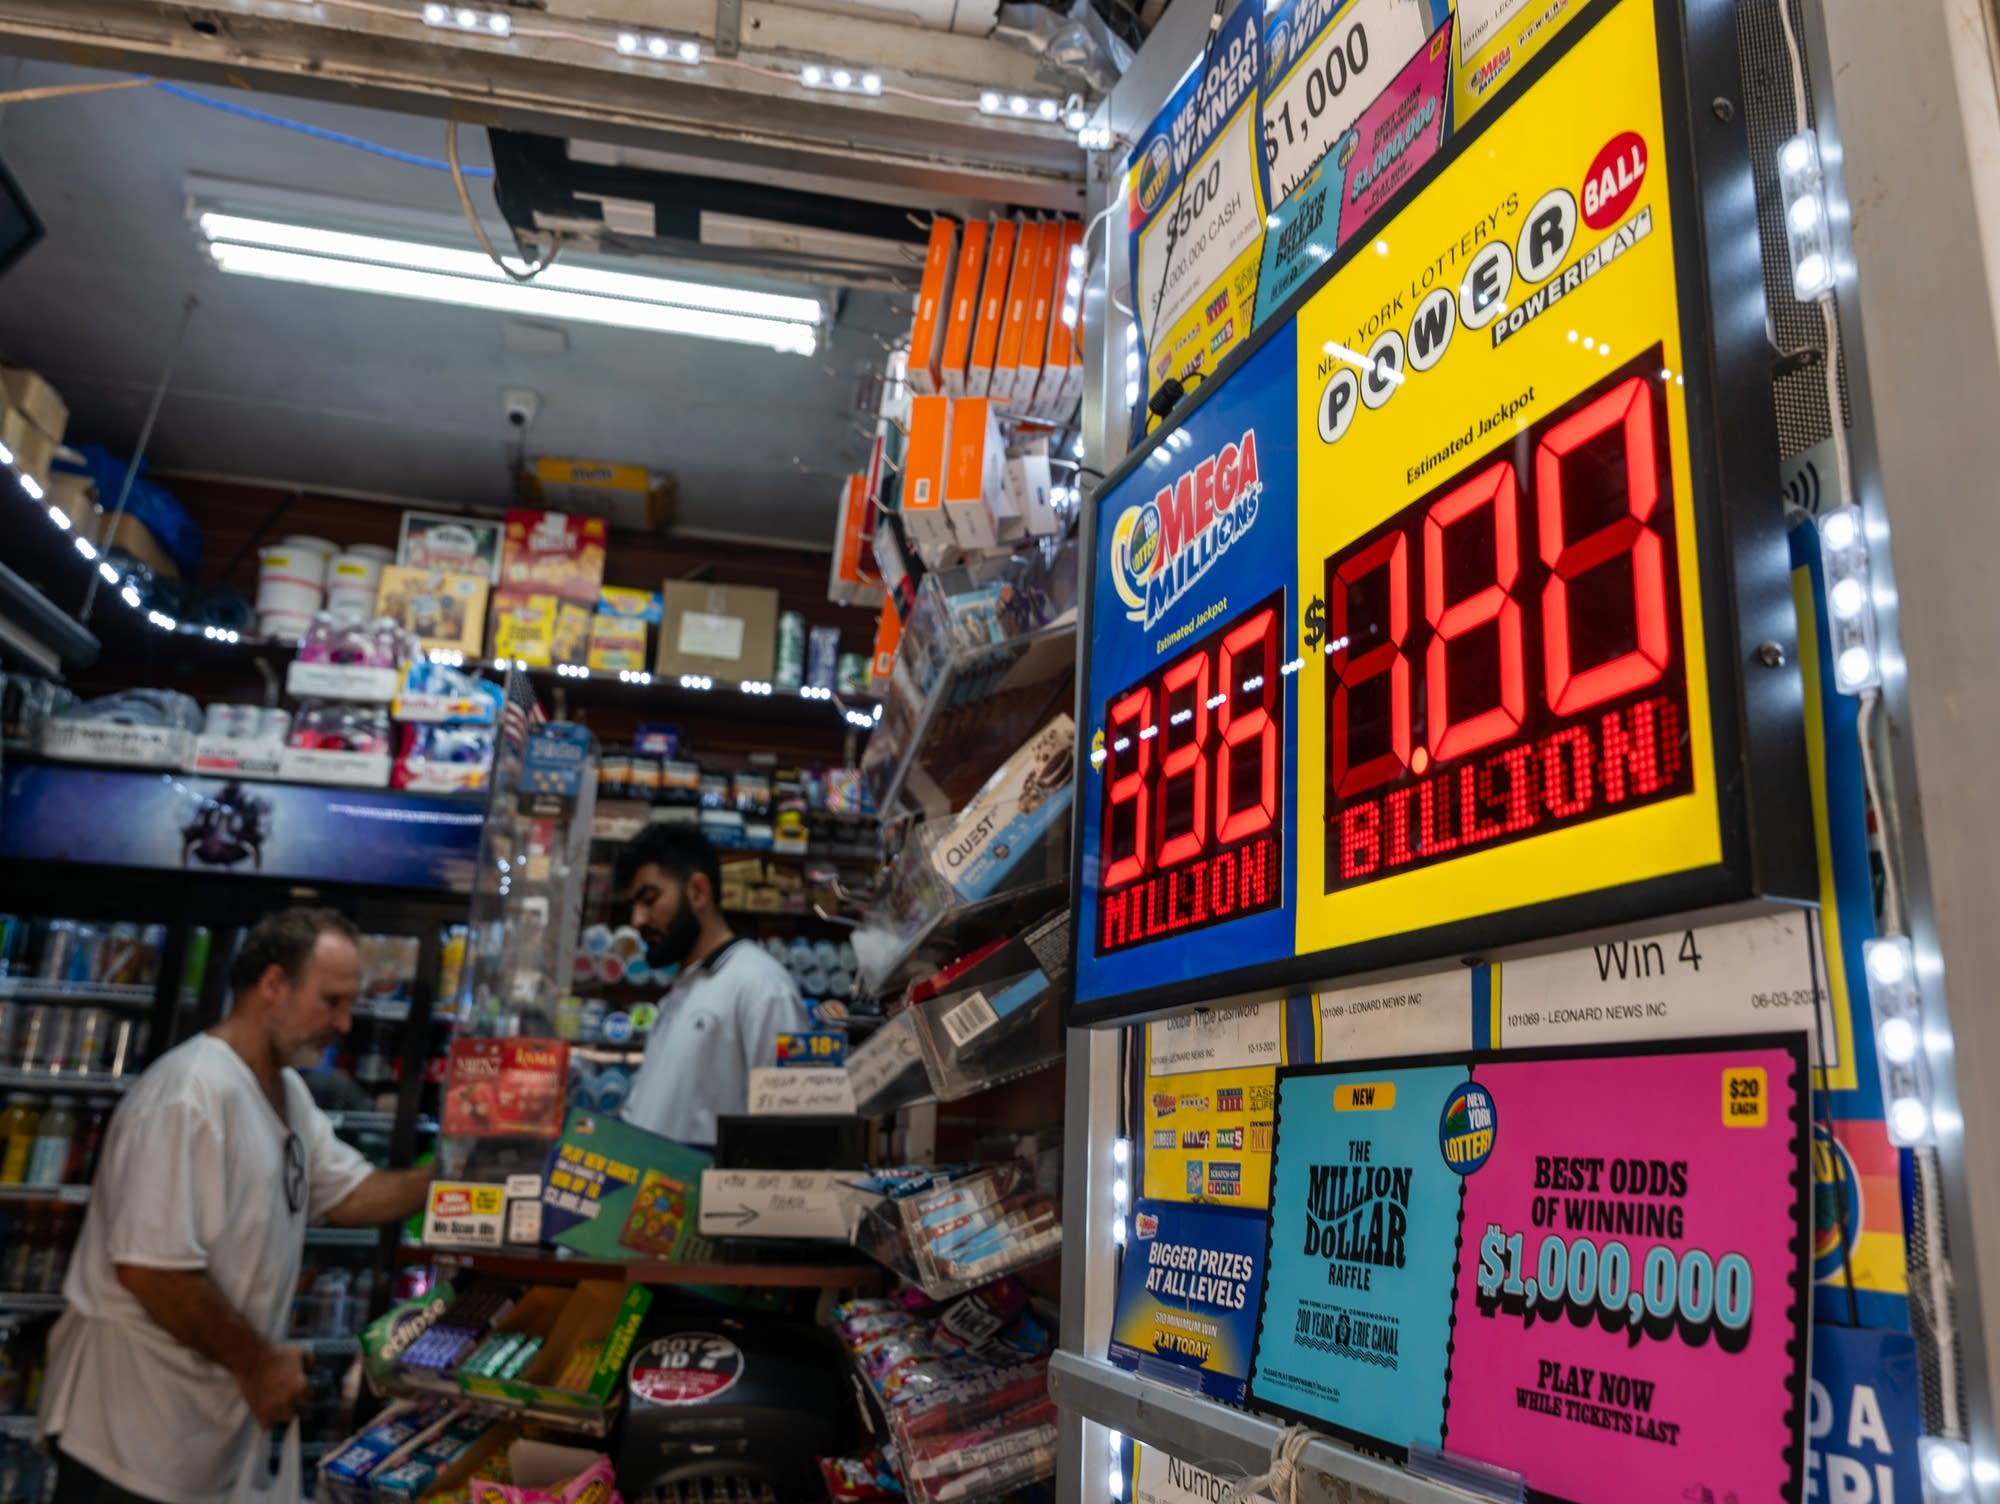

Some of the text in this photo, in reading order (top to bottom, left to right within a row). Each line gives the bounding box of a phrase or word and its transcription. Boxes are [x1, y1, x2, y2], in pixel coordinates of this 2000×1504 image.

[1172, 96, 1196, 144] WE
[1244, 17, 1257, 51] A
[1265, 22, 1368, 170] $1,000
[1166, 160, 1221, 254] $500
[1583, 145, 1645, 218] BALL
[1208, 193, 1242, 245] CASH
[1358, 292, 1404, 346] YORK
[1412, 192, 1520, 300] LOTTERY'S
[1406, 386, 1535, 485] Estimated Jackpot
[1151, 429, 1258, 577] MEGA
[1144, 483, 1262, 632] MILLIONS
[1156, 597, 1228, 654] Estimated Jackpot
[1104, 609, 1277, 889] 336
[1336, 697, 1658, 880] BILLION
[946, 815, 994, 867] QUEST
[1103, 842, 1271, 949] MILLION
[1593, 930, 1702, 981] Win 4
[1348, 999, 1381, 1015] LEONARD
[1382, 995, 1406, 1008] NEWS
[1407, 993, 1422, 1005] INC
[1507, 1013, 1540, 1027] 101069
[1548, 1007, 1602, 1025] LEONARD
[1603, 1004, 1643, 1020] NEWS
[1646, 1002, 1667, 1017] INC
[809, 1035, 841, 1056] 18+
[1352, 1088, 1375, 1107] NEW
[1467, 1092, 1486, 1108] NEW
[1730, 1078, 1759, 1099] $20
[1730, 1102, 1759, 1116] EACH
[1468, 1107, 1491, 1130] YORK
[1349, 1141, 1371, 1163] THE
[1445, 1128, 1493, 1163] LOTTERY
[1307, 1165, 1412, 1222] MILLION
[1534, 1156, 1688, 1199] BEST ODDS
[1303, 1201, 1407, 1269] DOLLAR
[1531, 1196, 1684, 1240] OF WINNING
[1148, 1241, 1253, 1282] BIGGER PRIZES
[1328, 1264, 1371, 1291] RAFFLE
[1477, 1224, 1754, 1340] $1,000,000
[1145, 1268, 1245, 1310] AT ALL LEVELS
[380, 1298, 446, 1361] eclipse
[651, 1338, 701, 1356] GOT
[1153, 1330, 1211, 1360] PLAY TODAY!
[1201, 1321, 1218, 1337] WIN
[1296, 1308, 1334, 1340] 200 YEARS
[1352, 1320, 1399, 1356] ERIE CANAL
[661, 1352, 690, 1369] ID
[1536, 1359, 1656, 1413] PLAY NOW
[1516, 1387, 1680, 1447] WHILE TICKETS LAST
[1847, 1384, 1893, 1455] A
